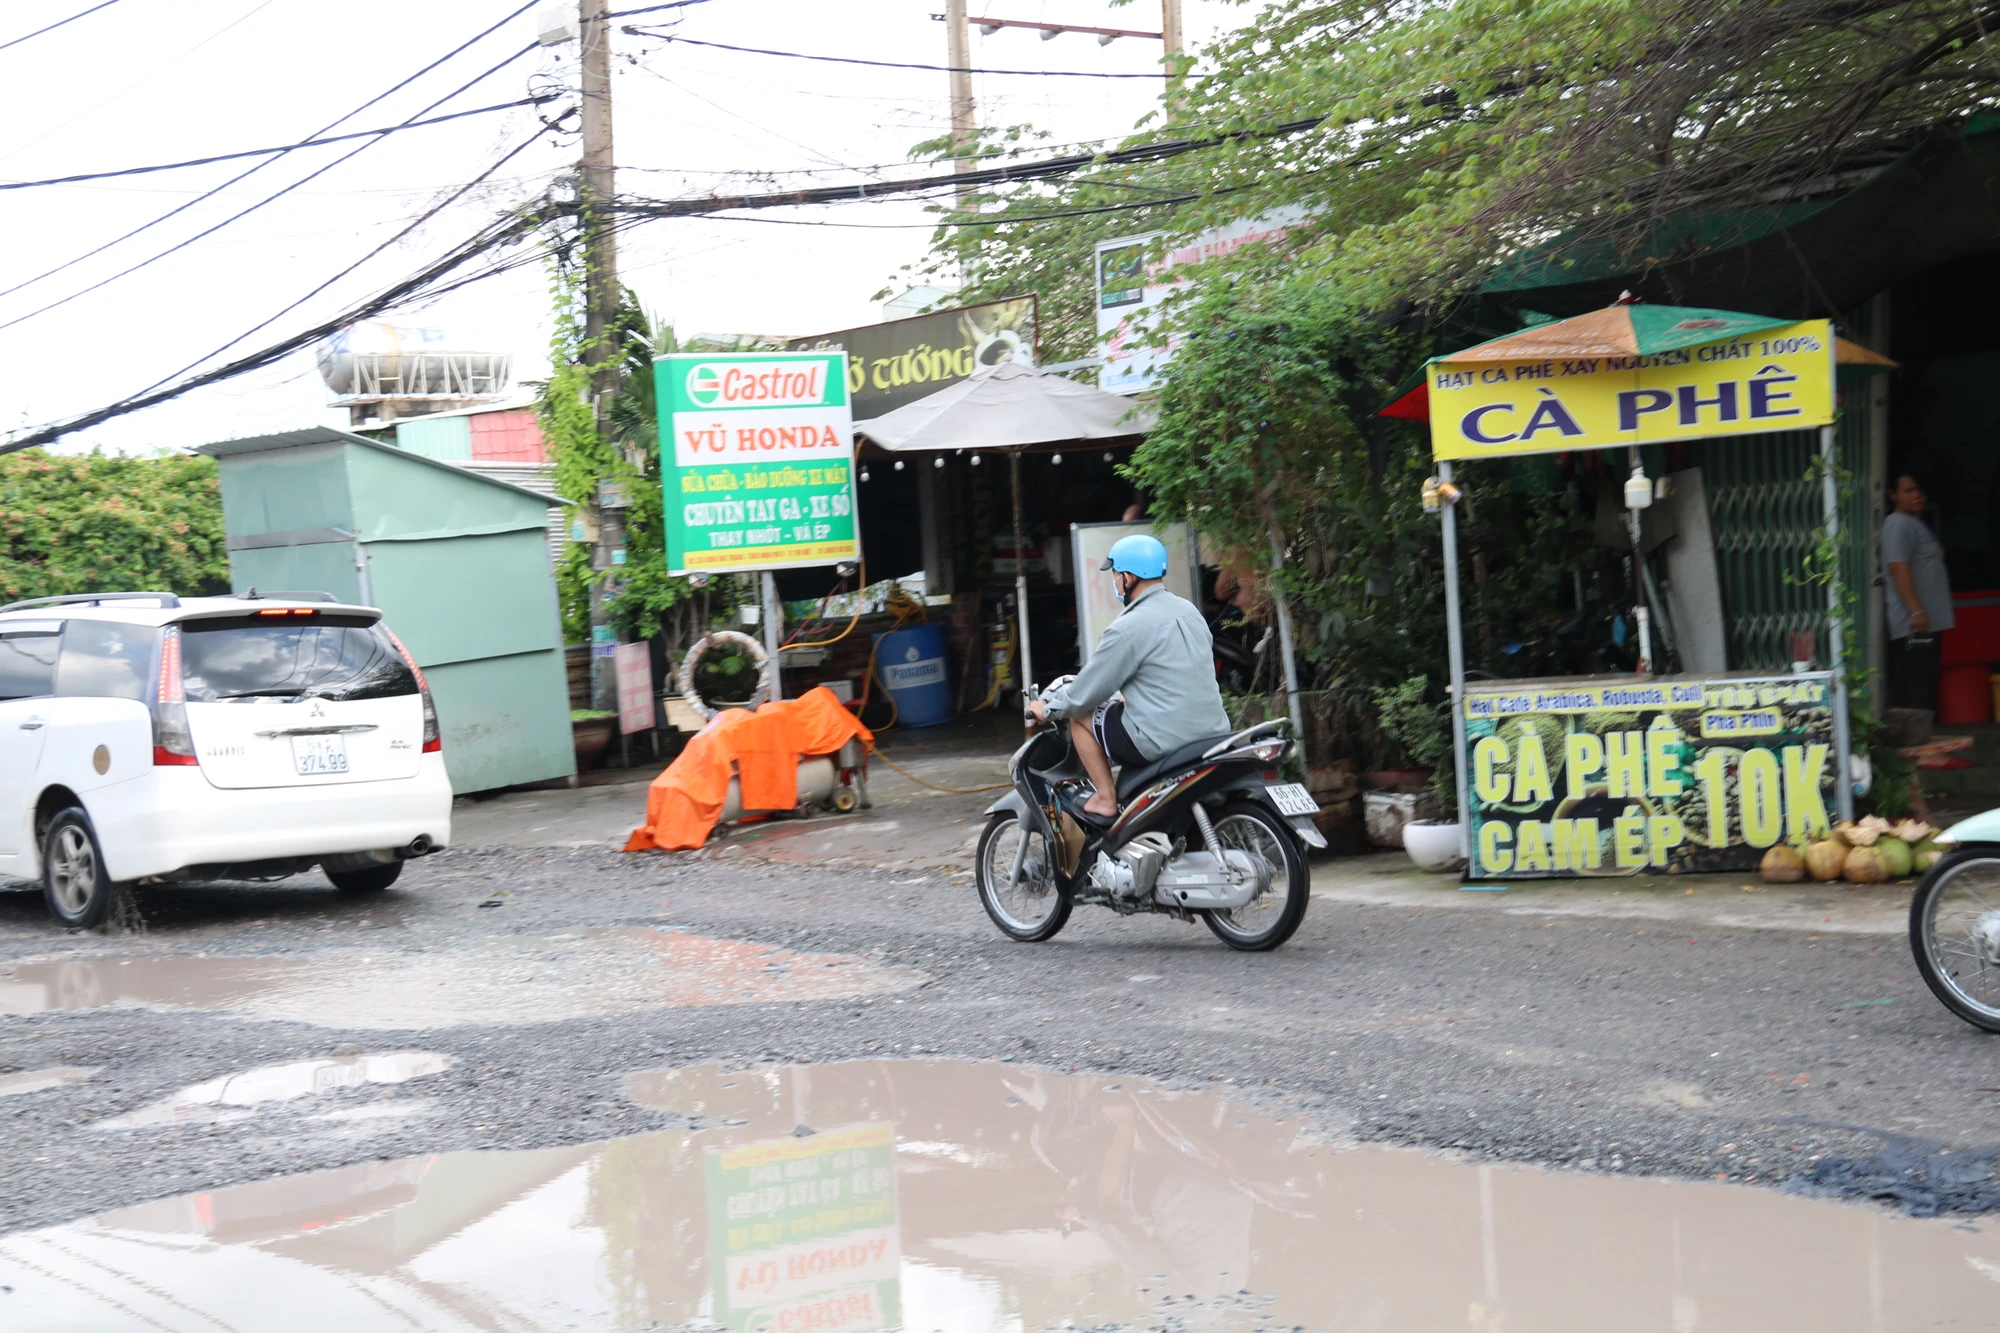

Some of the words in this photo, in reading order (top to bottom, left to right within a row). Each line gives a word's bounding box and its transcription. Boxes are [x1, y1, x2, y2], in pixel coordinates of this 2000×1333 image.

[723, 366, 819, 402] Castrol
[1436, 371, 1474, 393] HẠT
[1482, 362, 1509, 385] CÀ
[1515, 358, 1555, 380] PHÊ
[1561, 356, 1599, 377] XAY
[1697, 336, 1753, 363] CHẤT
[1758, 335, 1821, 358] 100%
[1460, 386, 1586, 445] CÀ
[1616, 364, 1802, 432] PHÊ
[684, 423, 728, 454] VŨ
[737, 425, 840, 452] HONDA
[684, 494, 745, 528] CHUYÊN
[746, 498, 778, 523] TAY
[779, 497, 802, 521] GA
[809, 495, 830, 519] XE
[831, 483, 851, 517] SỐ
[708, 530, 743, 548] THAY
[792, 522, 812, 542] VÁ
[813, 521, 831, 540] ÉP
[1473, 720, 1554, 802] CÀ
[1565, 714, 1684, 800] PHÊ
[1695, 743, 1831, 849] 10K
[1478, 817, 1599, 873] CAM
[1613, 805, 1685, 869] ÉP
